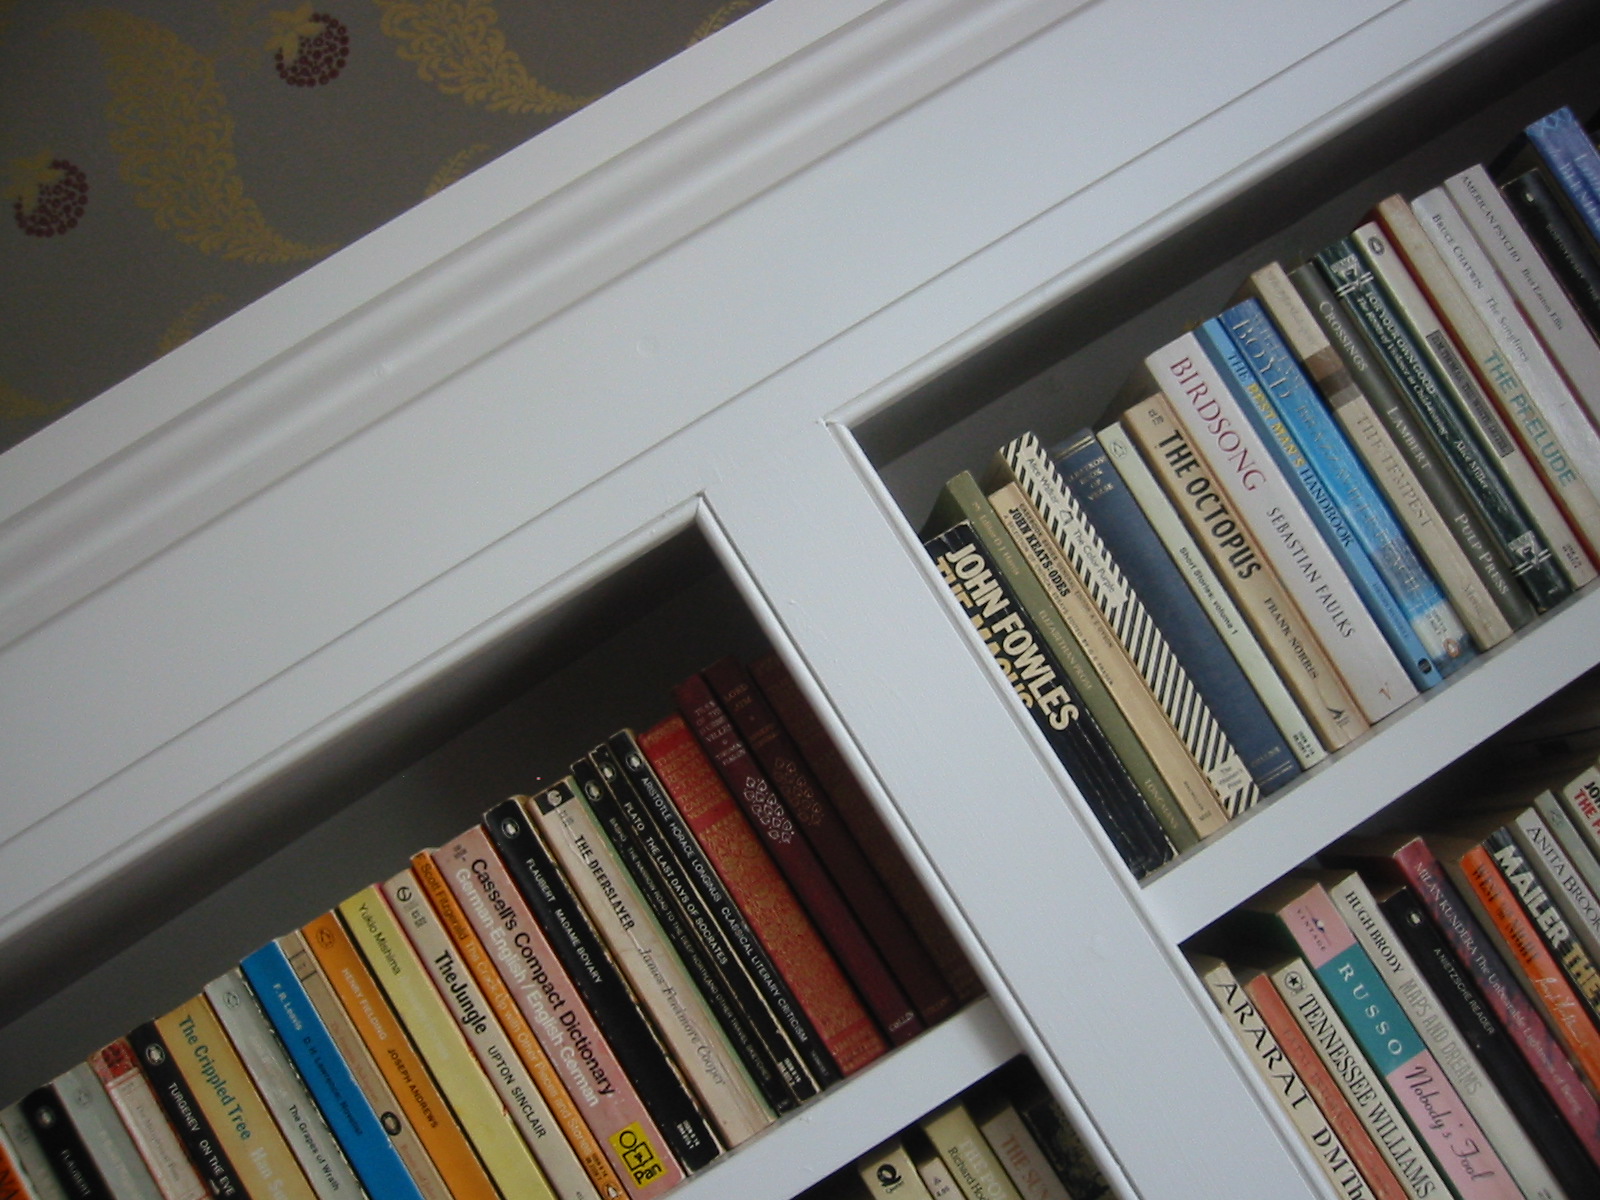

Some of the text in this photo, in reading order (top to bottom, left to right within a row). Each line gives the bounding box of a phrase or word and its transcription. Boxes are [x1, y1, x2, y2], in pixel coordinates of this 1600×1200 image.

[1430, 213, 1484, 291] BRUCE CHATWIN
[1459, 174, 1497, 225] AMERICAN
[1491, 223, 1522, 264] PSYCHO
[1231, 318, 1294, 402] BOYD
[1316, 298, 1370, 372] CROSSINGS
[1364, 288, 1437, 395] FOR YOUR OWN GOOD
[1483, 295, 1531, 364] The Songlines
[1168, 355, 1268, 494] BIRDSONG
[1225, 350, 1355, 548] THE BEST MAN'S HANDBOOK
[1385, 406, 1433, 472] LAMBERT
[1452, 438, 1473, 462] Alice
[1480, 349, 1518, 396] THE
[1506, 391, 1577, 488] PRELUDE
[1025, 455, 1062, 506] Alice Walker
[1155, 428, 1263, 581] THE OCTOPUS
[1354, 414, 1434, 528] THE TEMPEST
[1006, 504, 1033, 536] JOHN
[1070, 527, 1117, 595] The Color Purple
[1452, 512, 1485, 552] PULP
[1476, 550, 1512, 596] PRESS
[1177, 545, 1239, 636] Short Stories: volume 1
[1265, 505, 1356, 639] SEBASTIAN FAULKS
[943, 538, 1012, 620] JOHN
[988, 611, 1083, 734] FOWLES
[1037, 608, 1078, 666] ELIZABETHAN
[1262, 596, 1320, 681] FRANK NORRIS
[1570, 788, 1598, 819] THE
[414, 852, 427, 865] F.
[419, 862, 442, 892] Scott
[572, 834, 635, 932] THE DEERSLAYER
[622, 801, 729, 966] PLATO THE LAST DAYS OF SOCRATES
[1525, 822, 1568, 876] ANITA
[355, 902, 403, 976] Yukio Mishima
[433, 889, 470, 941] Fitzgerald
[464, 940, 483, 963] The
[524, 857, 603, 985] FLAUBERT MADAME BOVARY
[626, 846, 640, 862] THE
[652, 889, 669, 911] ROAD
[664, 910, 676, 922] TO
[704, 975, 719, 994] AND
[728, 1017, 750, 1045] TRAVEL
[639, 775, 673, 821] ARISTOTLE
[667, 821, 695, 858] HORACE
[690, 857, 723, 903] LONGINUS
[719, 905, 755, 956] CLASSICAL
[749, 954, 781, 998] LITERARY
[775, 996, 809, 1044] CRITICISM
[1295, 909, 1326, 953] VINTAGE
[1343, 890, 1404, 975] HUGH BRODY
[1413, 861, 1479, 955] MILAN KUNDERA
[1492, 843, 1574, 949] MAILER
[1556, 941, 1600, 1001] THE
[340, 966, 363, 999] HENRY
[358, 998, 388, 1041] FIELDING
[432, 949, 491, 1038] The Jungle
[468, 856, 618, 1099] Cassell's Compact Dictionary
[503, 1008, 523, 1033] with
[637, 945, 667, 986] James
[692, 1042, 728, 1089] Cooper
[1336, 962, 1405, 1058] RUSSO
[1432, 945, 1495, 1035] A NIETZSCHE READER
[1473, 953, 1492, 972] The
[1485, 971, 1527, 1028] Unbearable
[176, 1014, 256, 1142] The Crippled Tree
[516, 1031, 540, 1062] Other
[521, 989, 567, 1049] English
[556, 1044, 602, 1108] German
[533, 1060, 561, 1098] Pieces
[1213, 974, 1312, 1112] ARARAT
[1397, 977, 1484, 1096] MAPS AND DREAMS
[386, 1046, 412, 1084] JOSEPH
[407, 1082, 439, 1129] ANDREWS
[486, 1044, 547, 1139] UPTON SINCLAIR
[553, 1096, 573, 1119] and
[1294, 992, 1379, 1108] TENNESSEE
[1363, 1101, 1437, 1200] WILLIAMS
[1399, 1062, 1495, 1186] Nobody's Fool
[166, 1081, 235, 1196] TURGENEV ON THE EVE
[286, 1103, 342, 1192] The Grapes of Wrath
[565, 1116, 595, 1157] Stories
[631, 1159, 663, 1186] Pan
[998, 1134, 1031, 1172] THE
